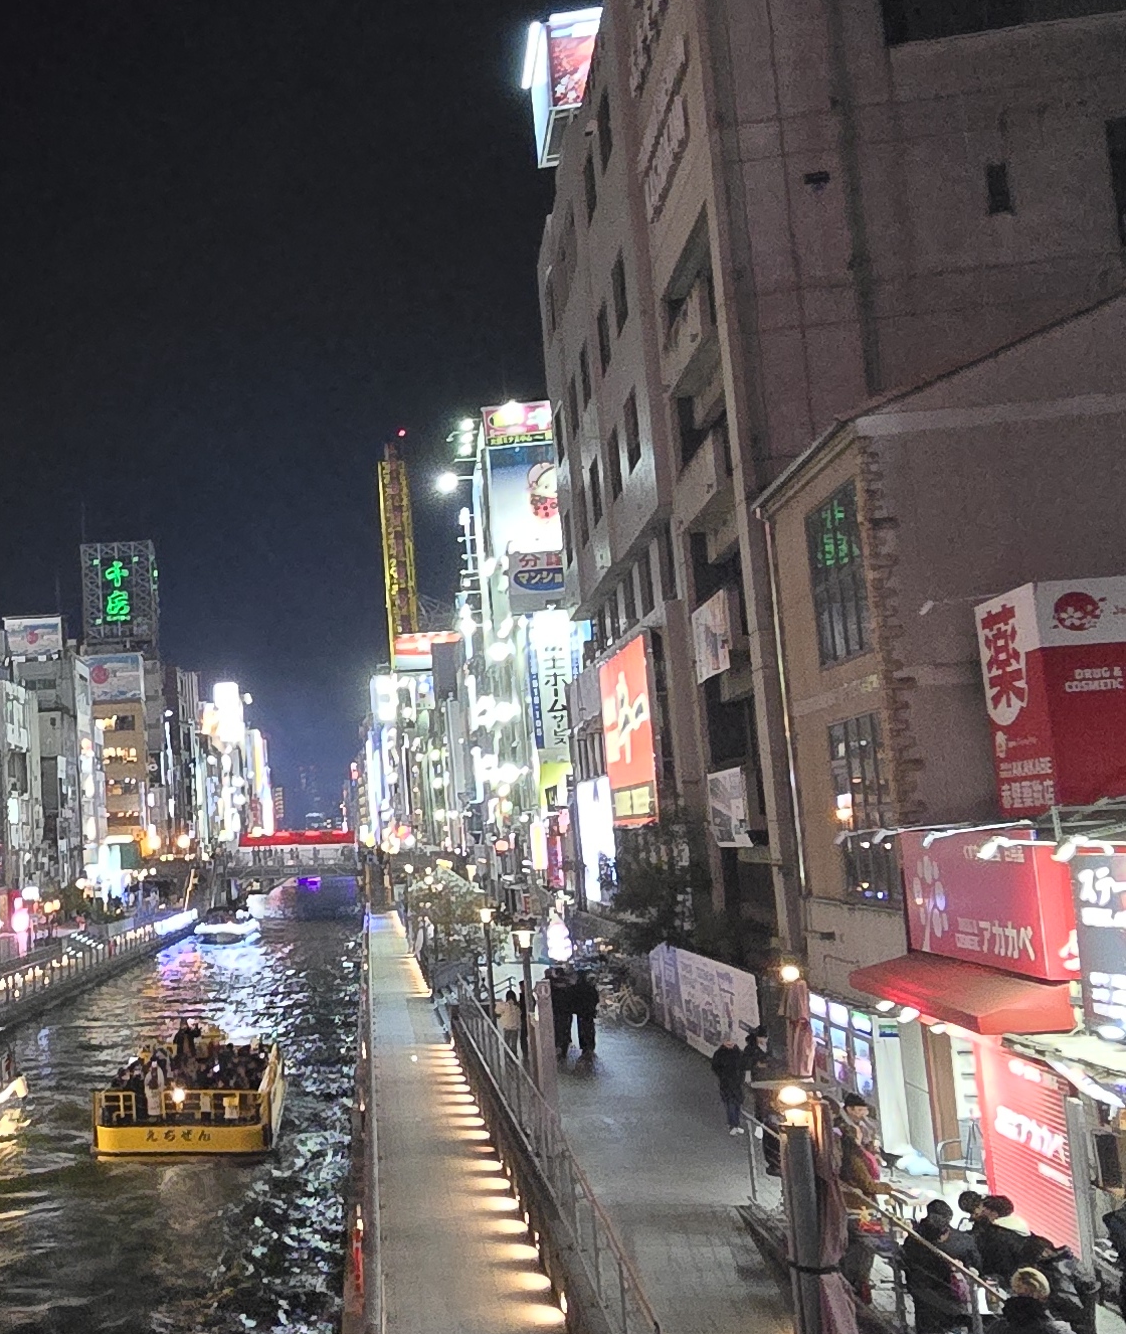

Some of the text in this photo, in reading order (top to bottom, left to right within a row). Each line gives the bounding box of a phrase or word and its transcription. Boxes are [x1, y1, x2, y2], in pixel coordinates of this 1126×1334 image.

[105, 561, 130, 615] 千房
[980, 603, 1027, 711] 薬
[1074, 667, 1110, 680] DRUG
[145, 1128, 211, 1143] えちぜん
